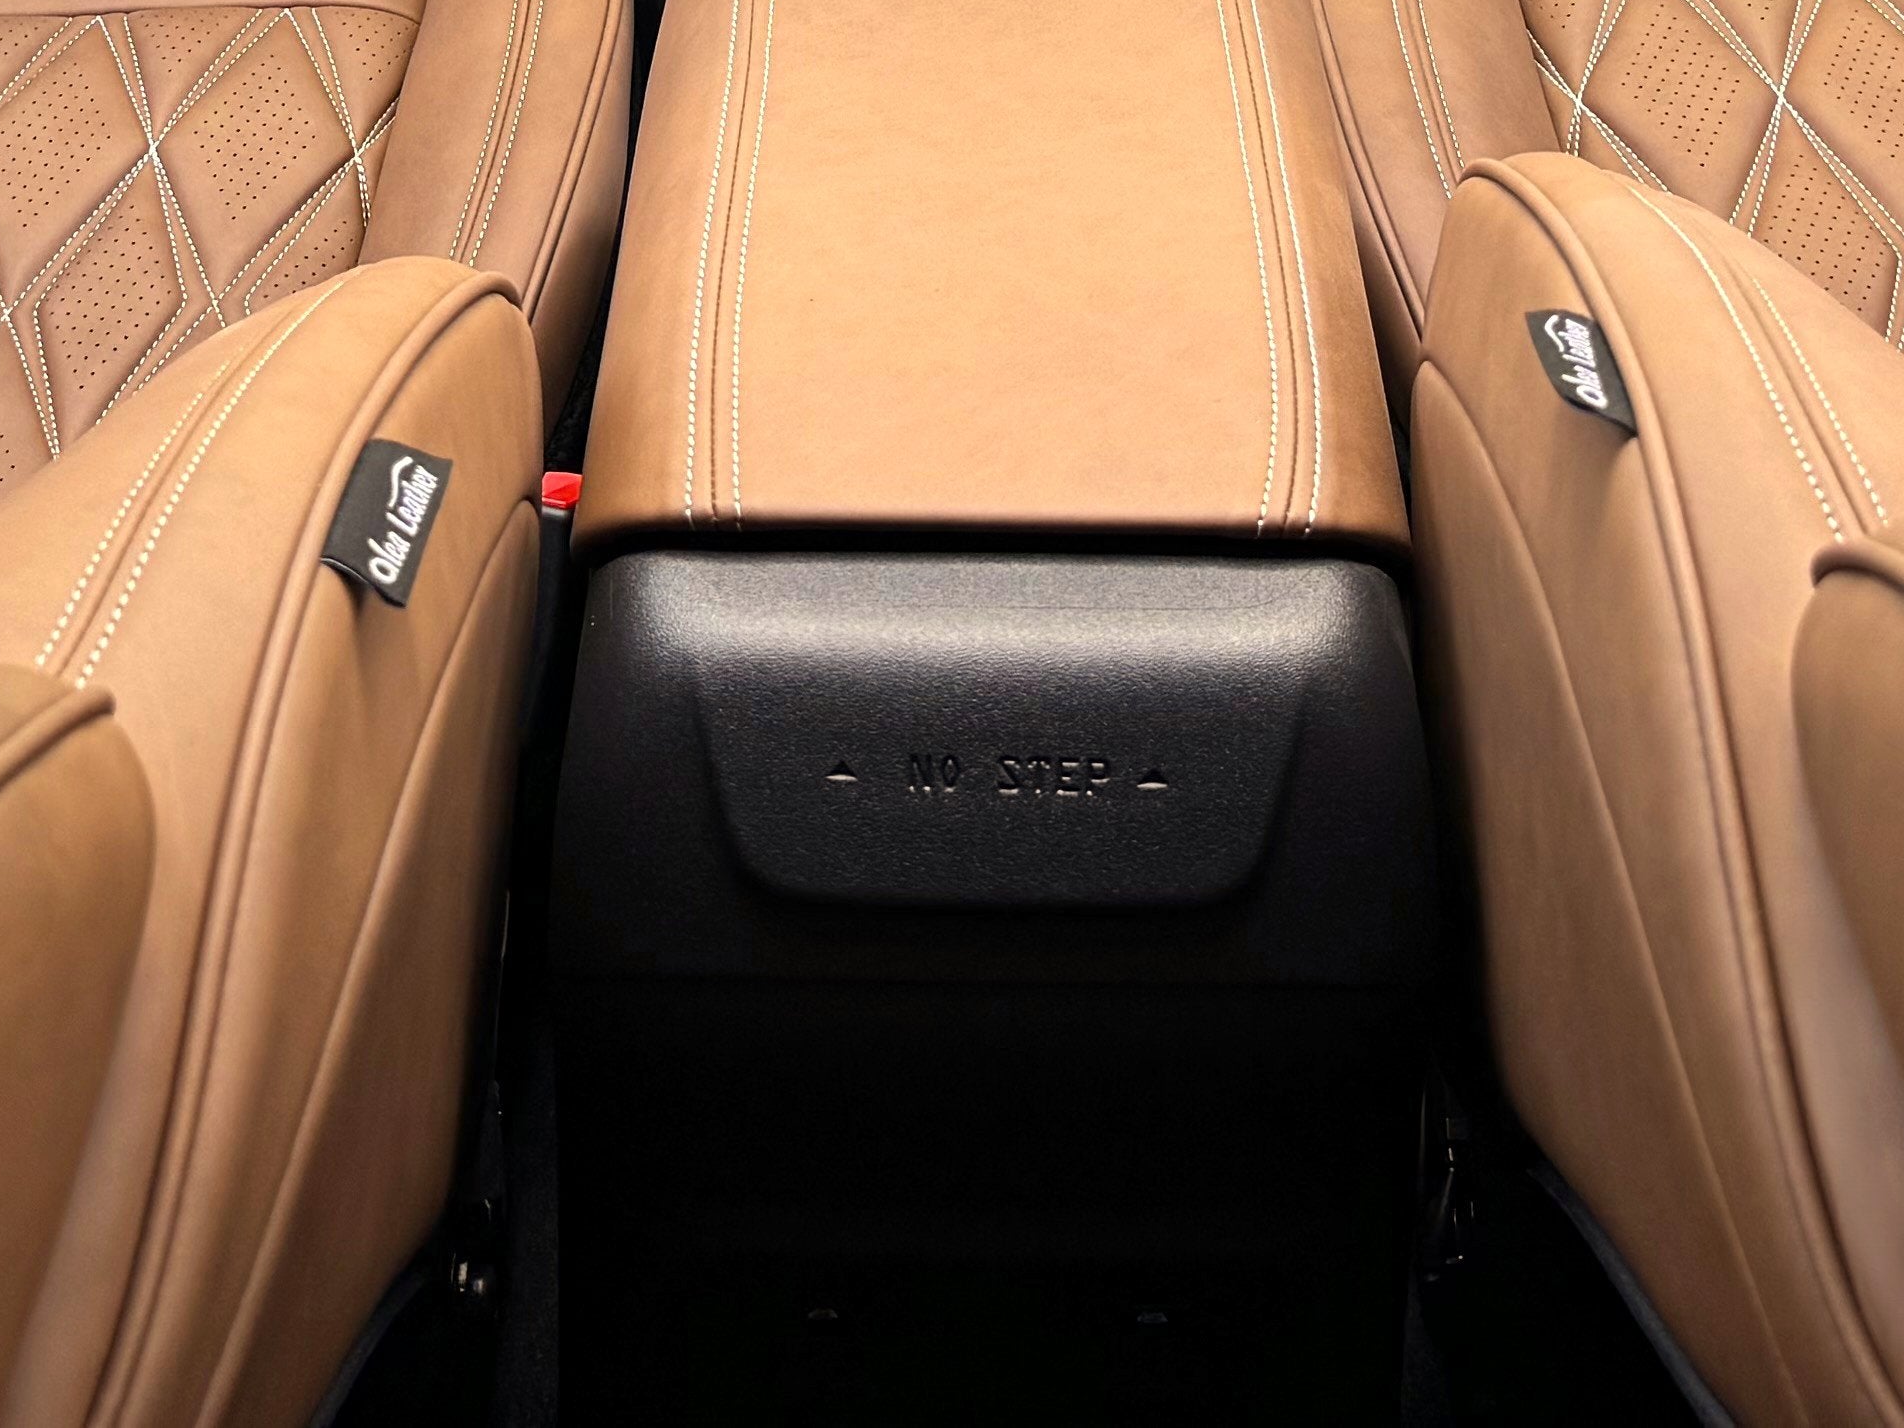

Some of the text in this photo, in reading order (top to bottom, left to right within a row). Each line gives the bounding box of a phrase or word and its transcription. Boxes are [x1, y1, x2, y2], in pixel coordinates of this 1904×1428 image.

[367, 464, 439, 585] Olea Leather
[909, 754, 1112, 798] NO STEP
